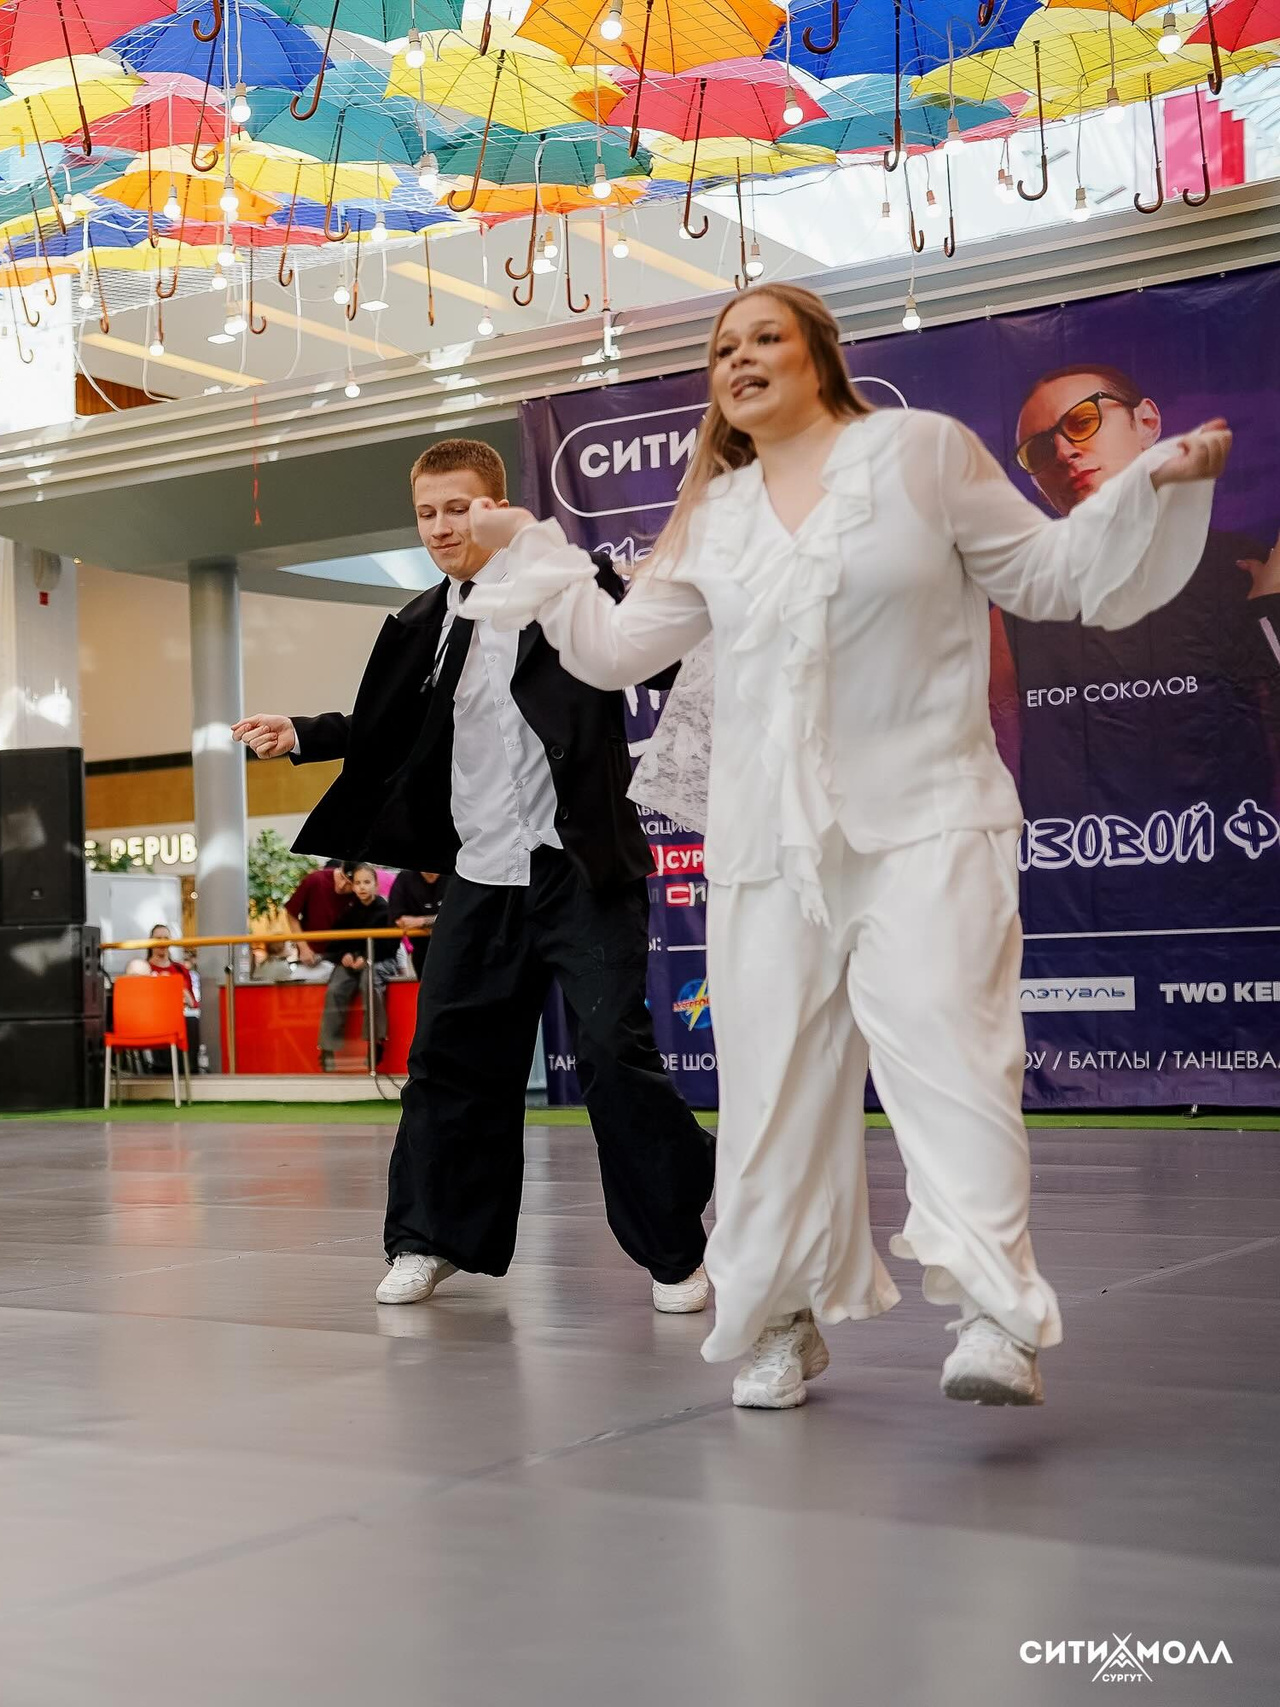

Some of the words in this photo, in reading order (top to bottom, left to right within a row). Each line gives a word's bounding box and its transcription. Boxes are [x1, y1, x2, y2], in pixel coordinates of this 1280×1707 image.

[579, 427, 697, 478] СИТИ
[1026, 686, 1077, 708] ЕГОР
[1083, 675, 1199, 702] СОКОЛОВ
[1160, 982, 1227, 1004] TWO
[682, 1052, 719, 1071] ШО
[1069, 1050, 1150, 1070] БАТТЛЫ
[1173, 1050, 1280, 1071] ТАНЦЕВА
